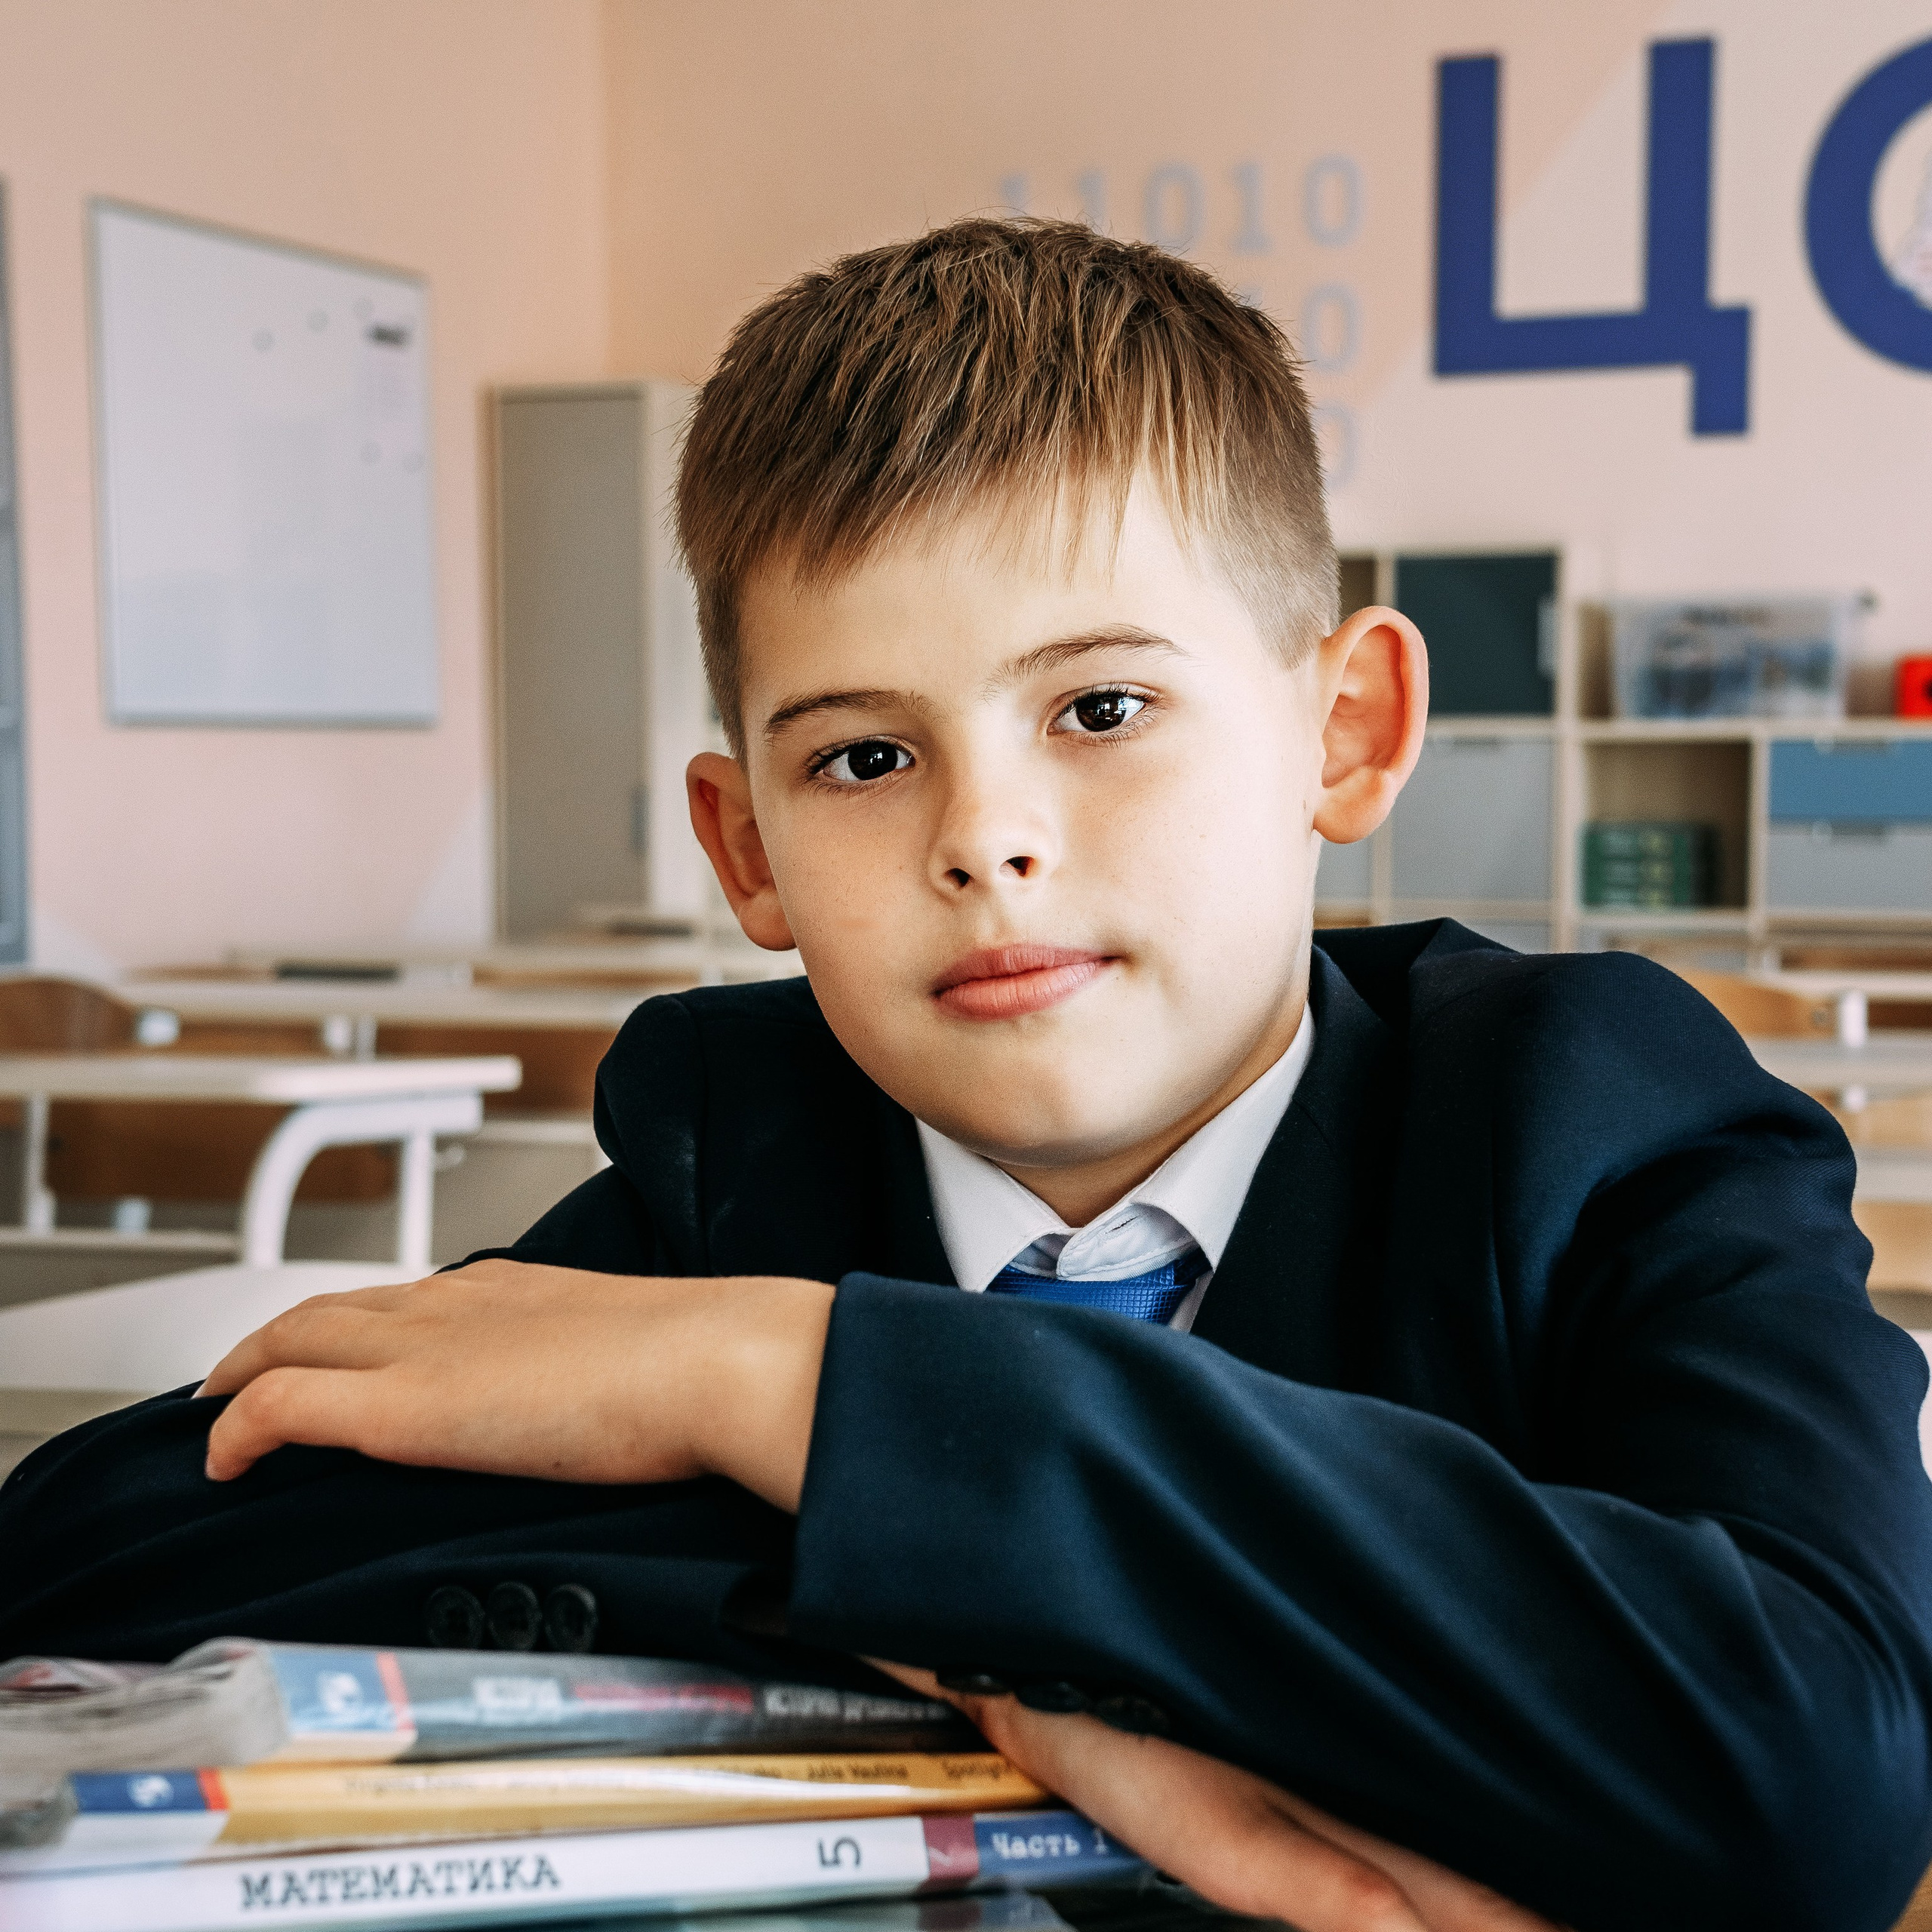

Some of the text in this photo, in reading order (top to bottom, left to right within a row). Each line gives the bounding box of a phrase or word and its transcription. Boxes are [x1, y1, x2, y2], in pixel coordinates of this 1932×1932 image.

[817, 1837, 860, 1867] 5
[992, 1832, 1081, 1860] Часть
[240, 1854, 560, 1909] МАТЕМАТИКА
